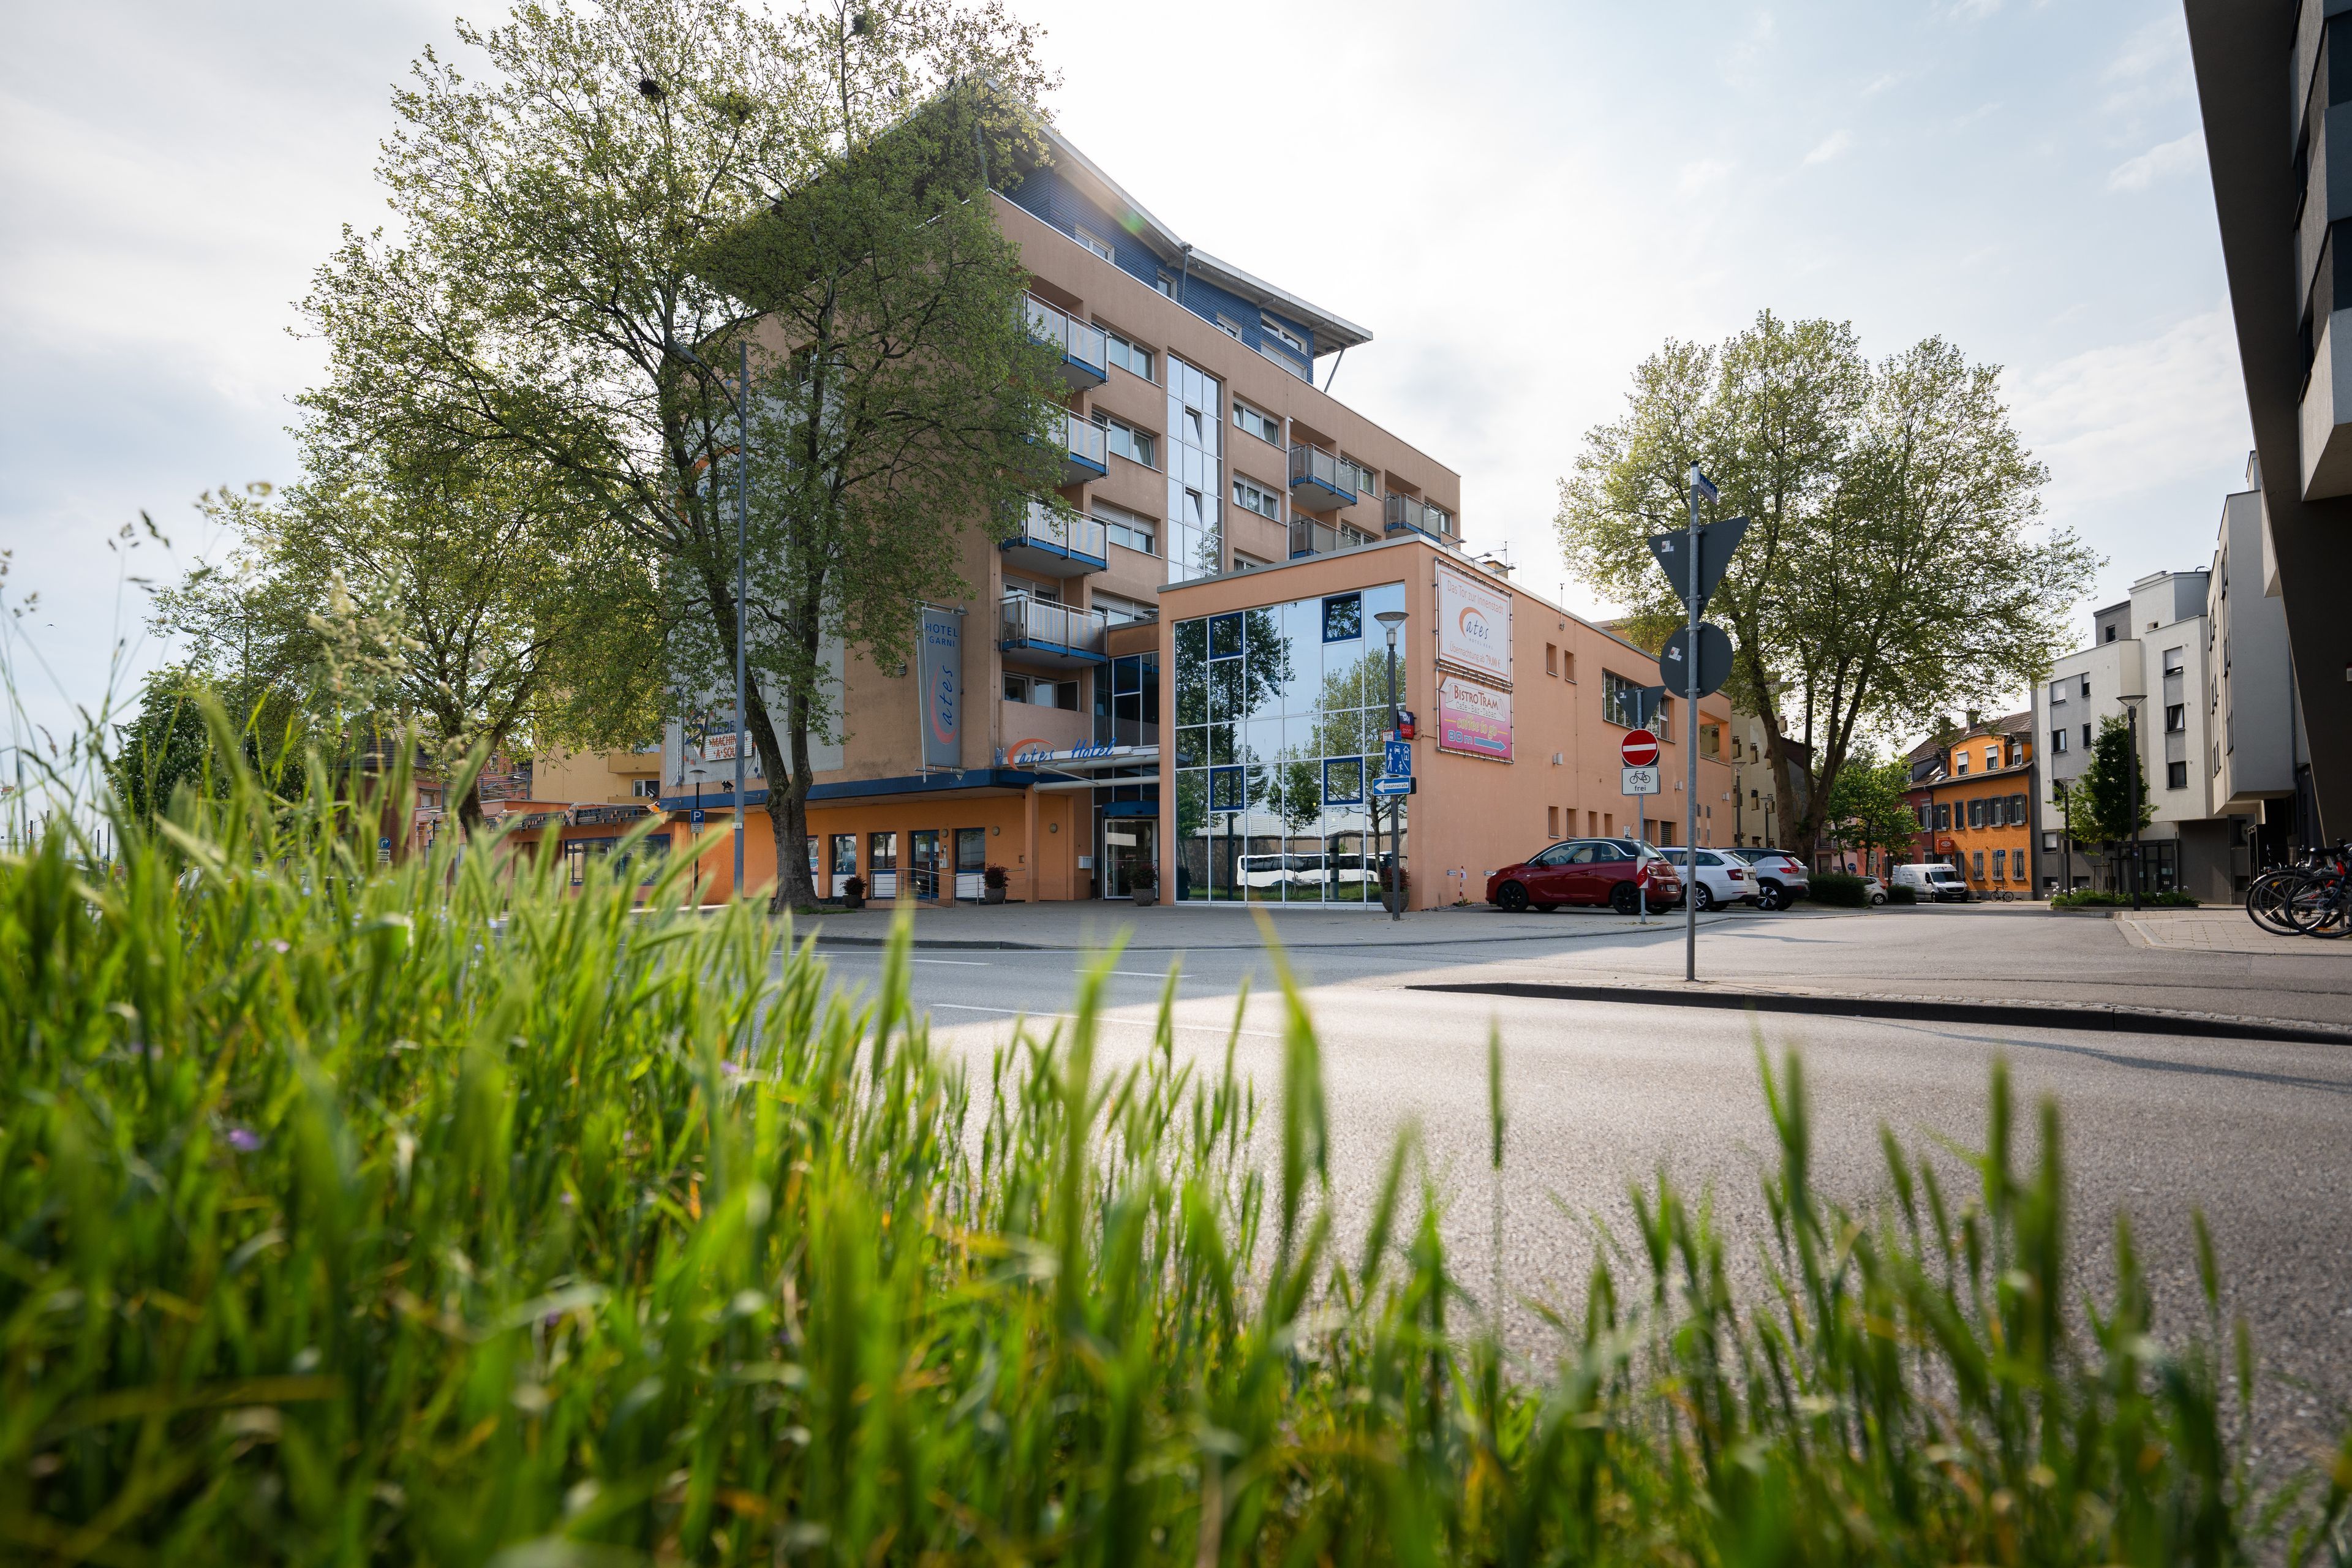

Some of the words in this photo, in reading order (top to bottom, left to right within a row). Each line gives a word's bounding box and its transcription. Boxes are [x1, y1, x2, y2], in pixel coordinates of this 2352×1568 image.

[1447, 580, 1457, 594] Das
[1458, 585, 1467, 598] Tor
[1477, 593, 1503, 615] Innenstadt
[925, 622, 958, 638] HOTEL
[929, 636, 956, 647] GARNI
[1450, 641, 1479, 663] Übernachtung
[1480, 654, 1485, 663] ab
[1457, 714, 1480, 732] coffee
[1480, 720, 1488, 734] to
[1488, 725, 1498, 740] go
[1071, 737, 1117, 759] Hotel
[693, 812, 701, 821] P
